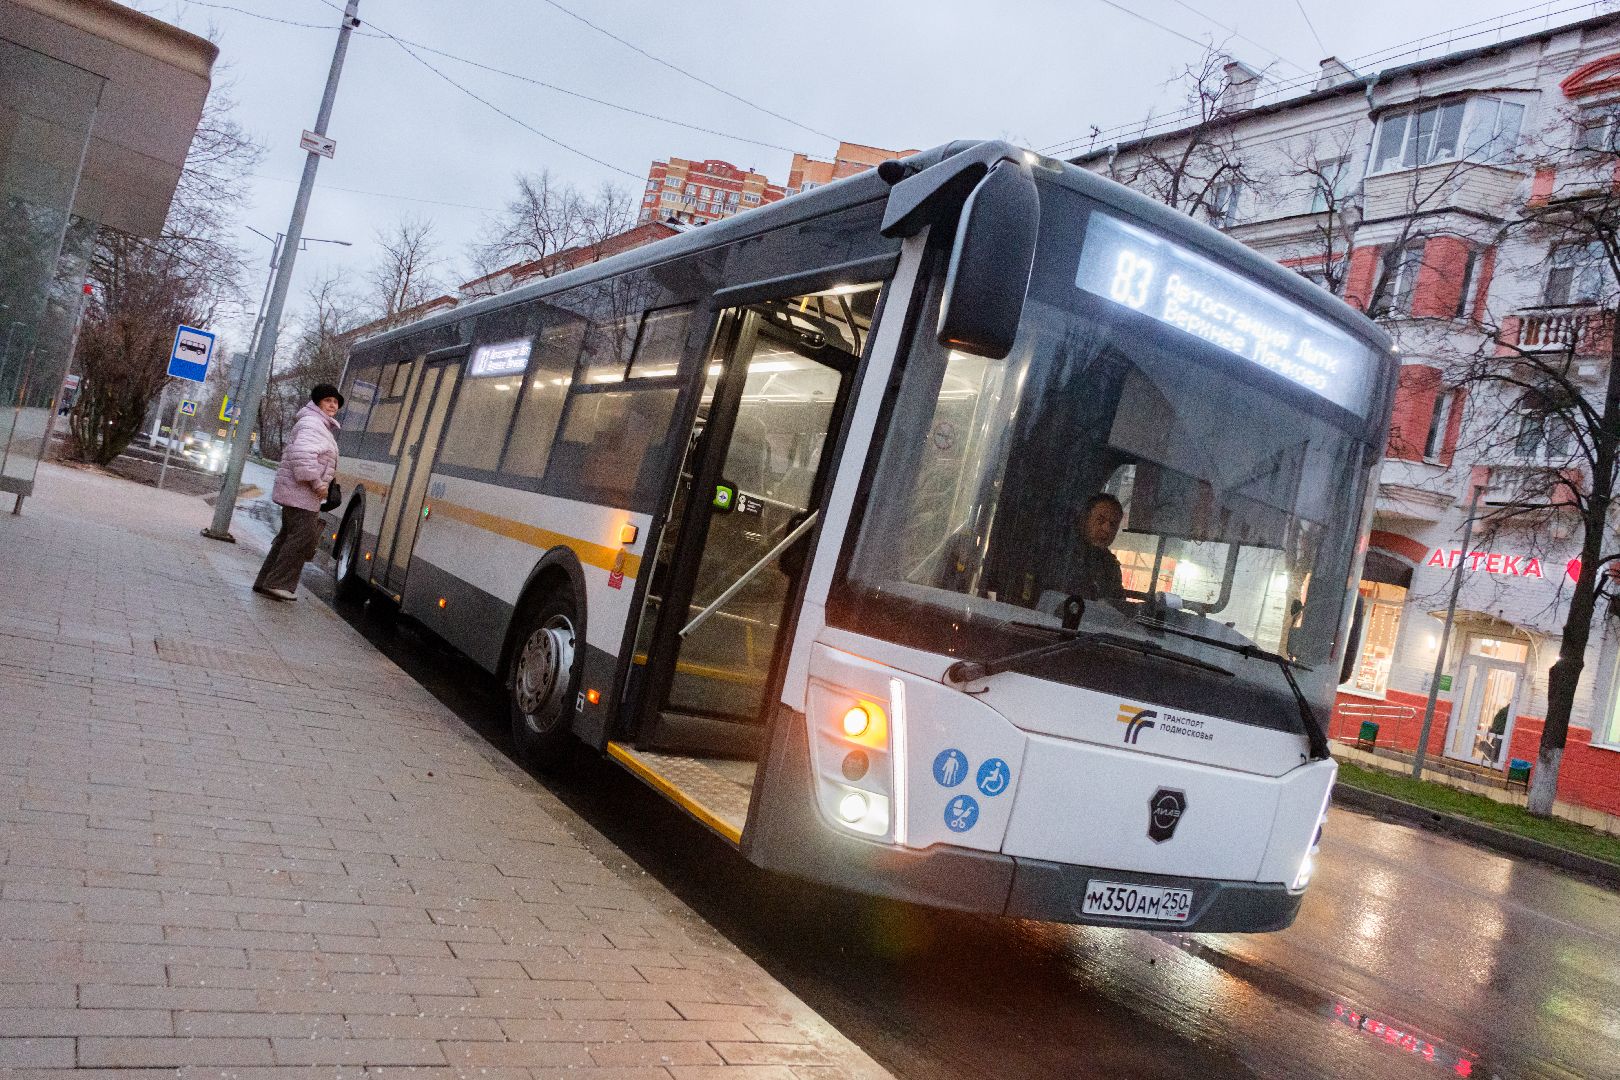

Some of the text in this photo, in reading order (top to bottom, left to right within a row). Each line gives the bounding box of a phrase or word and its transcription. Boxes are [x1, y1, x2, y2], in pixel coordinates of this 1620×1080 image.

[1110, 249, 1155, 309] 83
[1165, 273, 1291, 350] Автостанция
[1163, 297, 1328, 390] Верхнее Мячково
[1427, 548, 1543, 579] АПТЕКА
[1160, 723, 1214, 741] ПОДМОСКОВЬЯ
[1163, 713, 1204, 729] ТРАНСПОРТ
[1089, 887, 1187, 915] М350АМ 250
